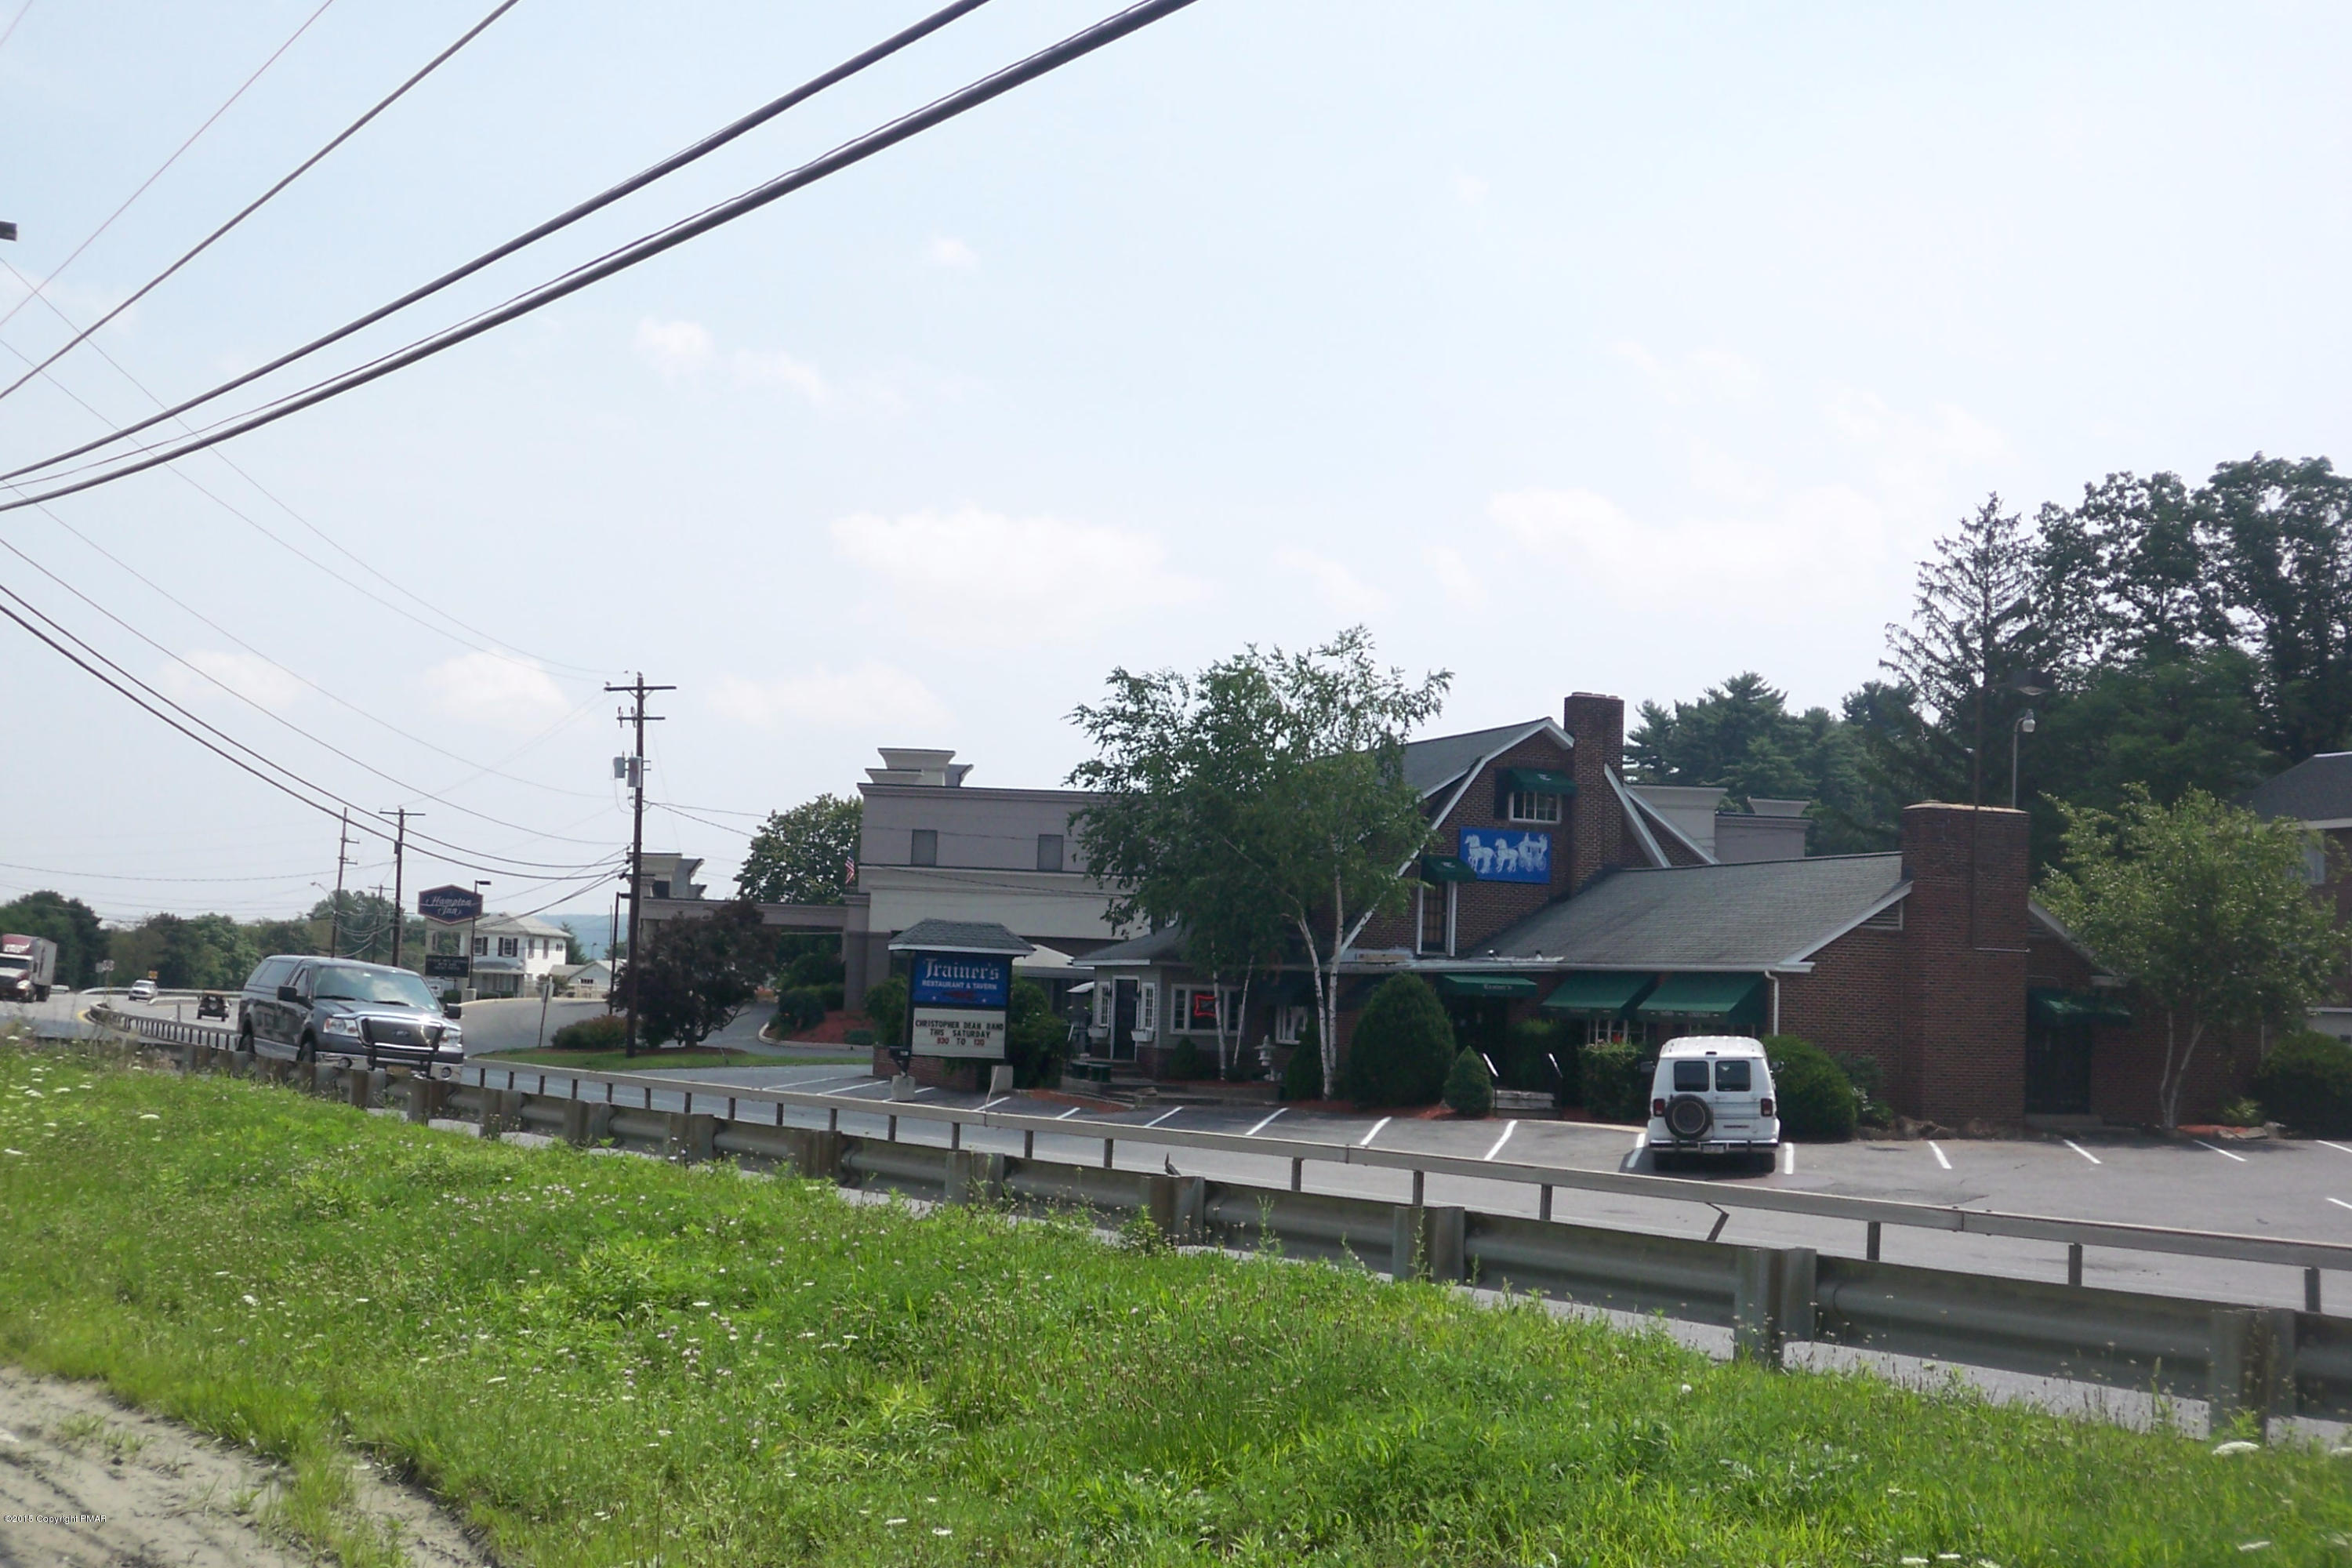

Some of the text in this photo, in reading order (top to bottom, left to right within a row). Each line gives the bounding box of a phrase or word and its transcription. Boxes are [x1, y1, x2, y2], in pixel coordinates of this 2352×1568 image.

[924, 958, 999, 980] Trainer's
[922, 980, 964, 989] RESTAURANT
[915, 1019, 960, 1029] CHRISTOPHER
[953, 1029, 991, 1038] SATURDAY
